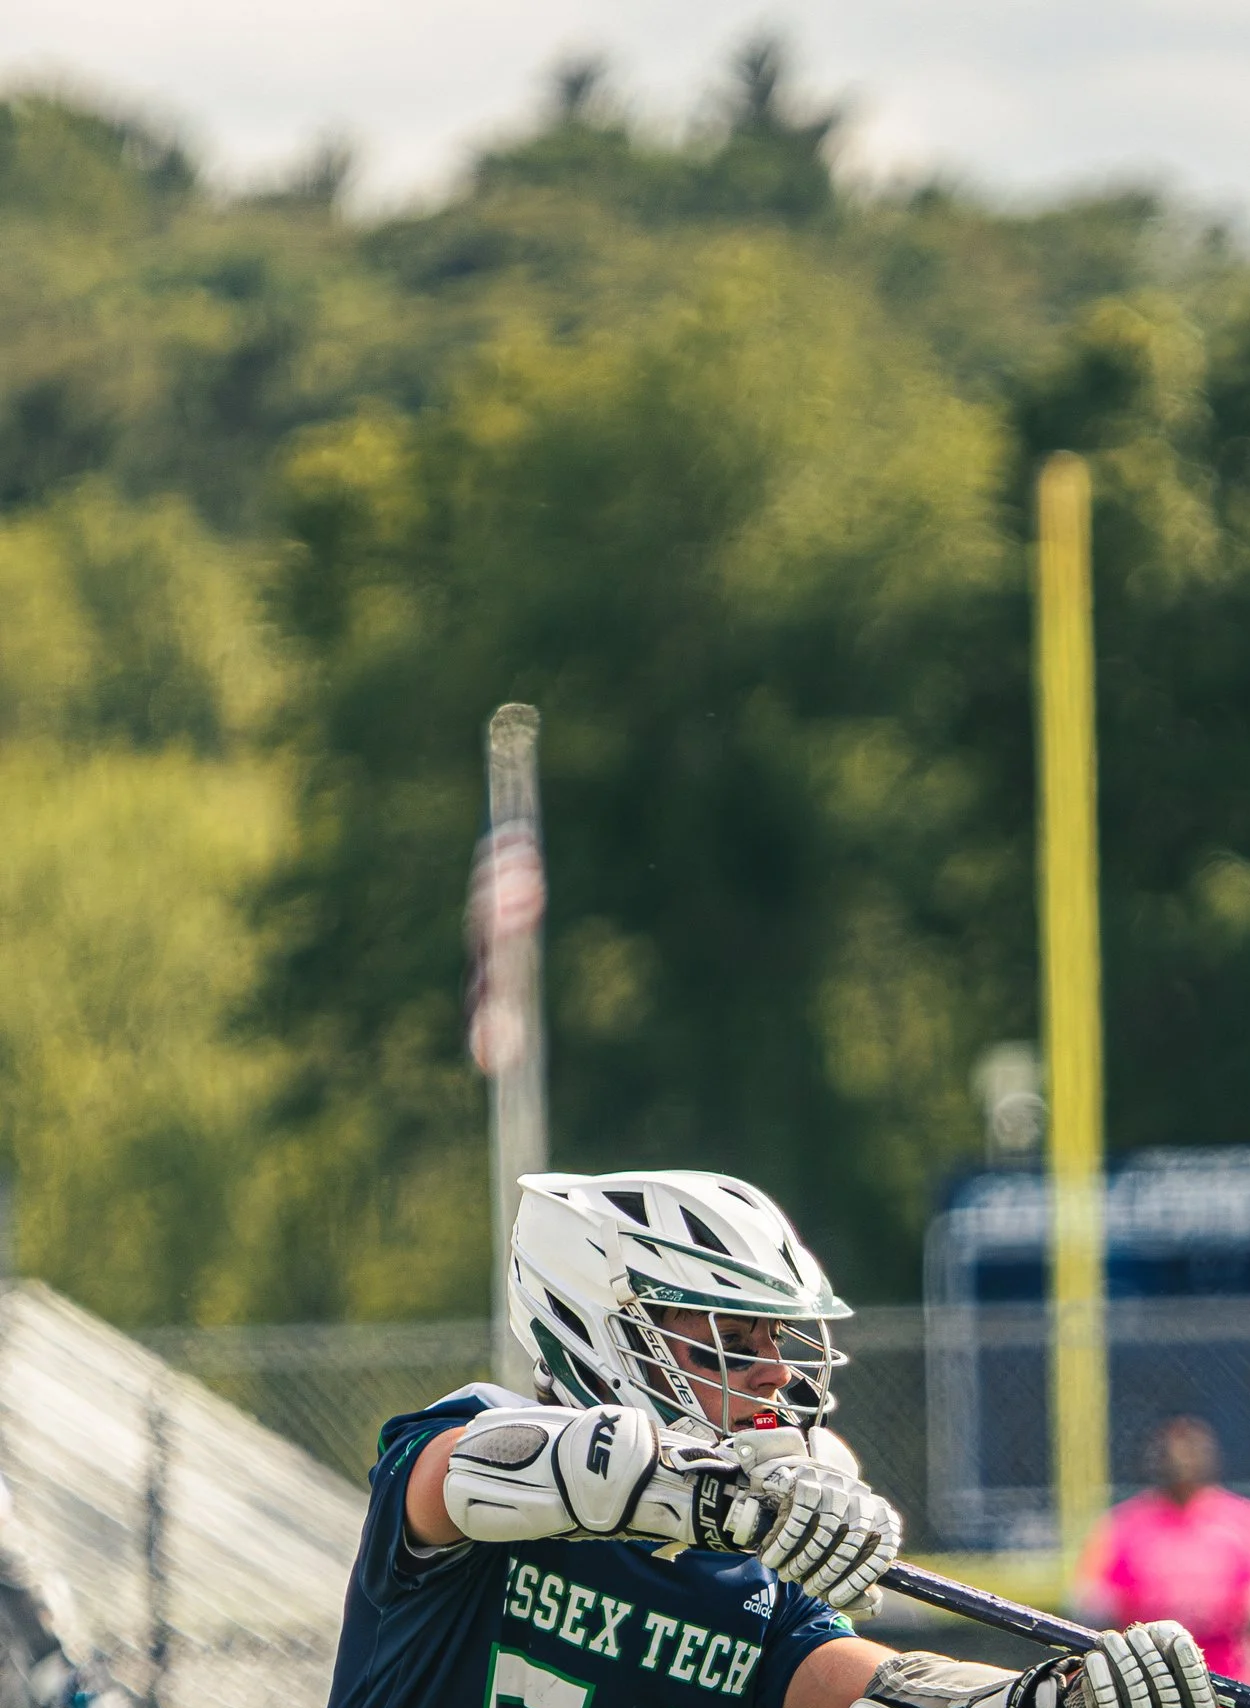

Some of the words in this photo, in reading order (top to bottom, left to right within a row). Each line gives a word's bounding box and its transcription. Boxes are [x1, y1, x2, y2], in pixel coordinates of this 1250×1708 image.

[586, 1411, 621, 1480] STX
[756, 1416, 774, 1425] STX
[504, 1556, 636, 1661] SSEX
[638, 1608, 763, 1698] TECH
